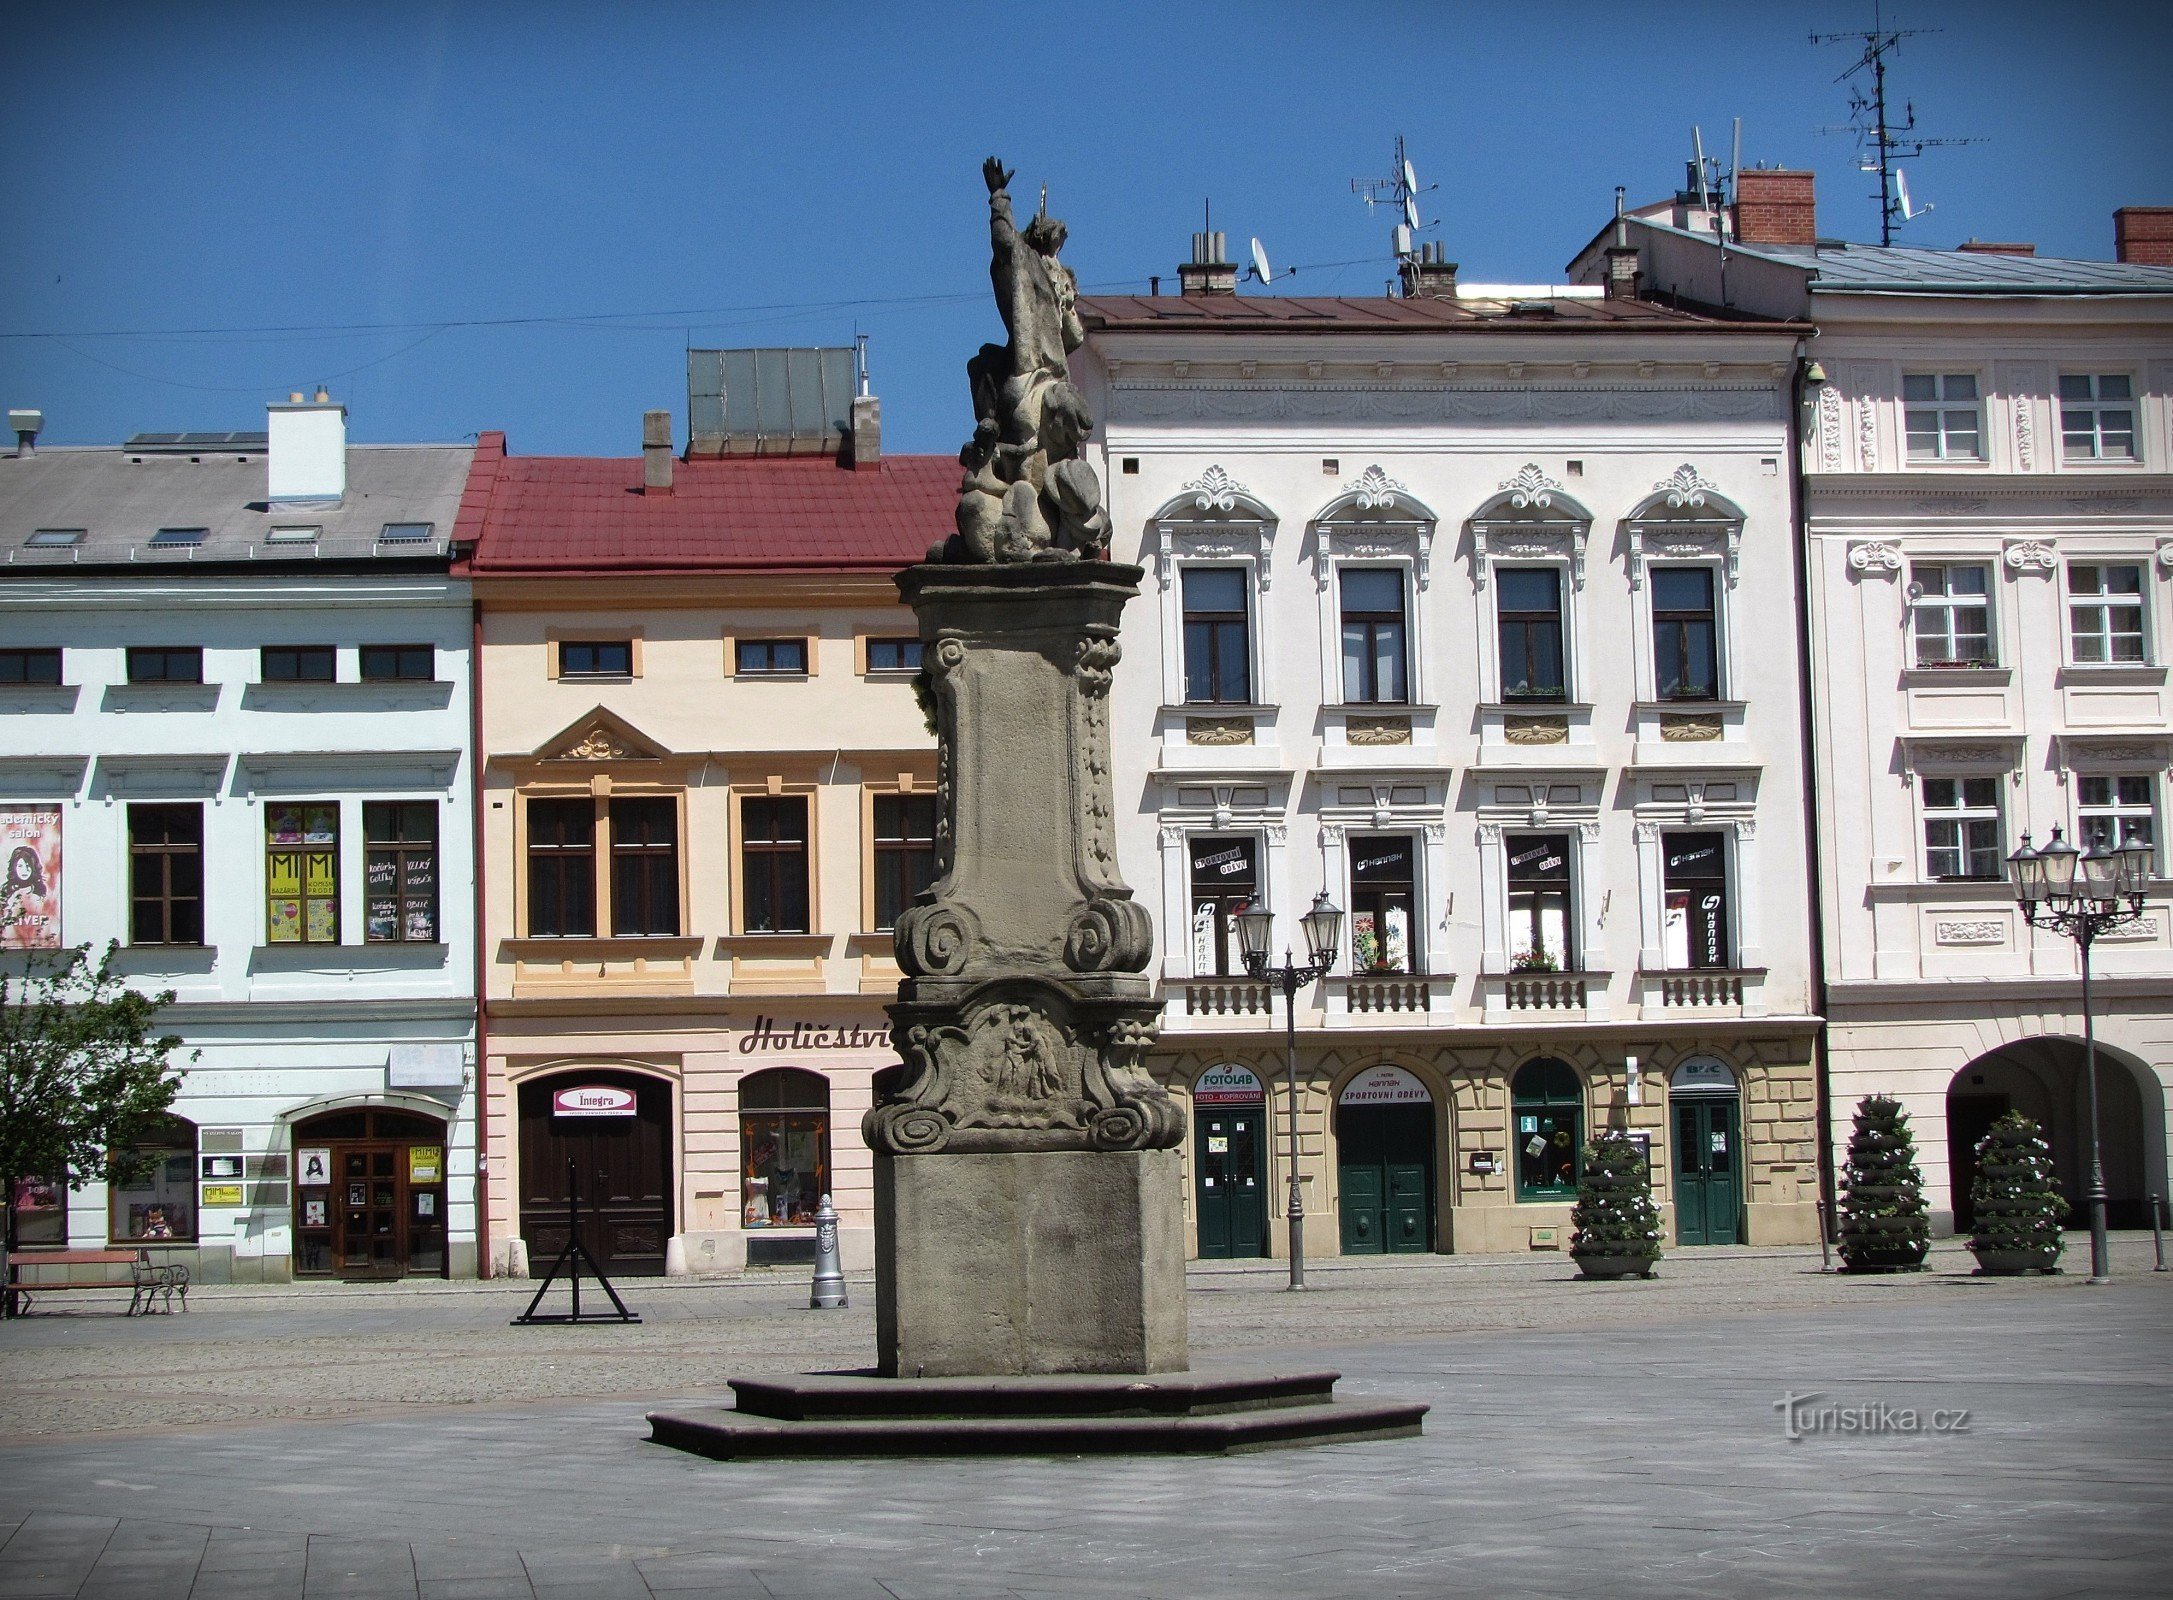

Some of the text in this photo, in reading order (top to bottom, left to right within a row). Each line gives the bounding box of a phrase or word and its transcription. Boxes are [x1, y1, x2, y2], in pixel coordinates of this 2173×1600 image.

[9, 829, 41, 838] salon
[1196, 847, 1241, 868] SPORTOVNÍ
[1221, 861, 1247, 874] ODĚVY
[738, 1015, 890, 1054] Holičství
[1204, 1075, 1253, 1085] FOTOLAB
[1219, 1092, 1260, 1100] KOPÍROVÁNÍ
[1345, 1088, 1425, 1100] SPORTOVNÍ ODĚVY
[205, 1187, 224, 1196] MIMI
